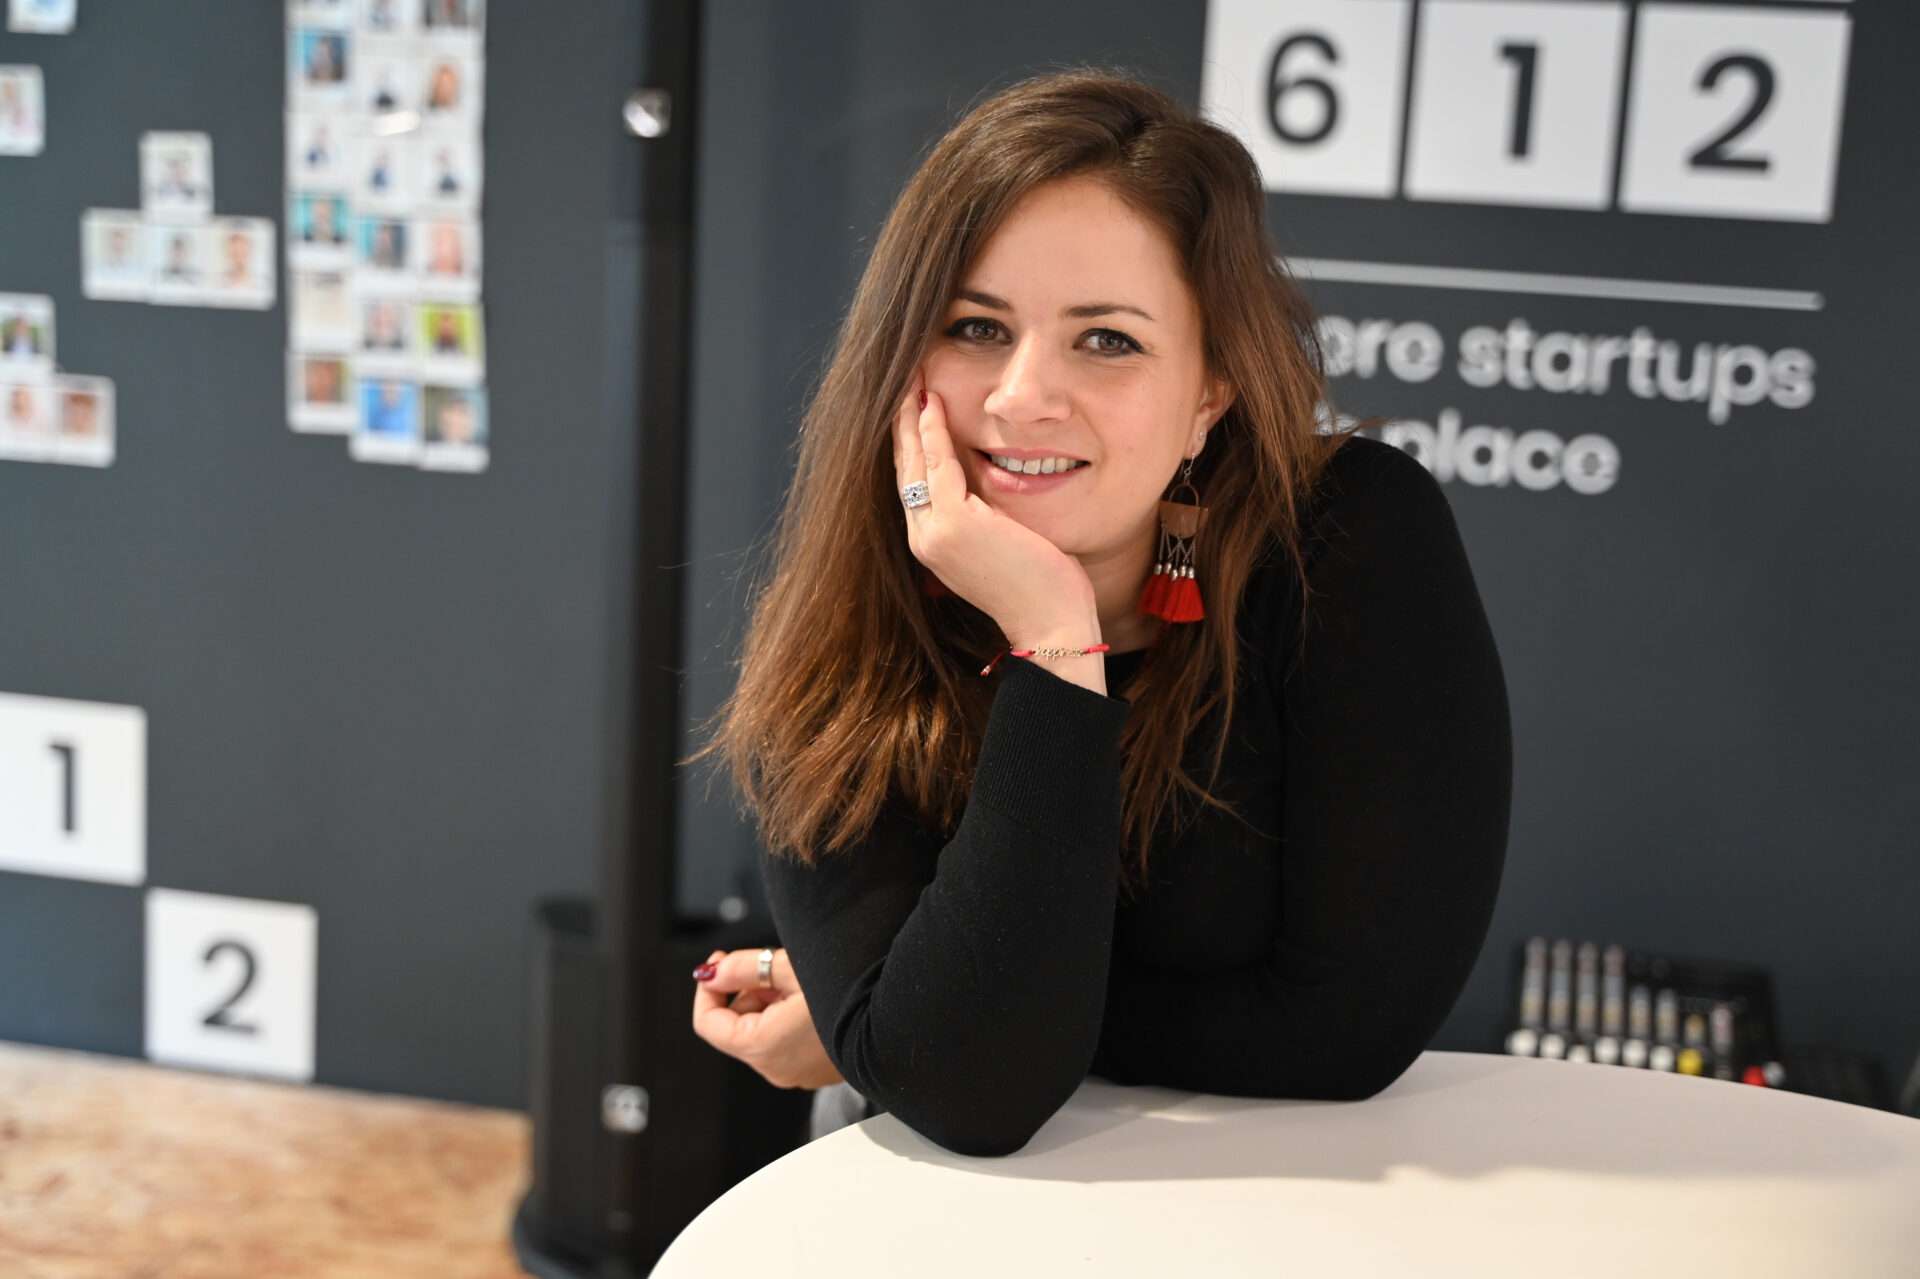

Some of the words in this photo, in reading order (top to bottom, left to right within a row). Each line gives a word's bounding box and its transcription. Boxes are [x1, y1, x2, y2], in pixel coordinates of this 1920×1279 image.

[1265, 32, 1341, 146] 6
[1497, 42, 1538, 159] 1
[1687, 53, 1776, 173] 2
[1296, 315, 1445, 382] ere
[1457, 317, 1816, 425] startups
[48, 741, 76, 833] 1
[201, 939, 259, 1034] 2
